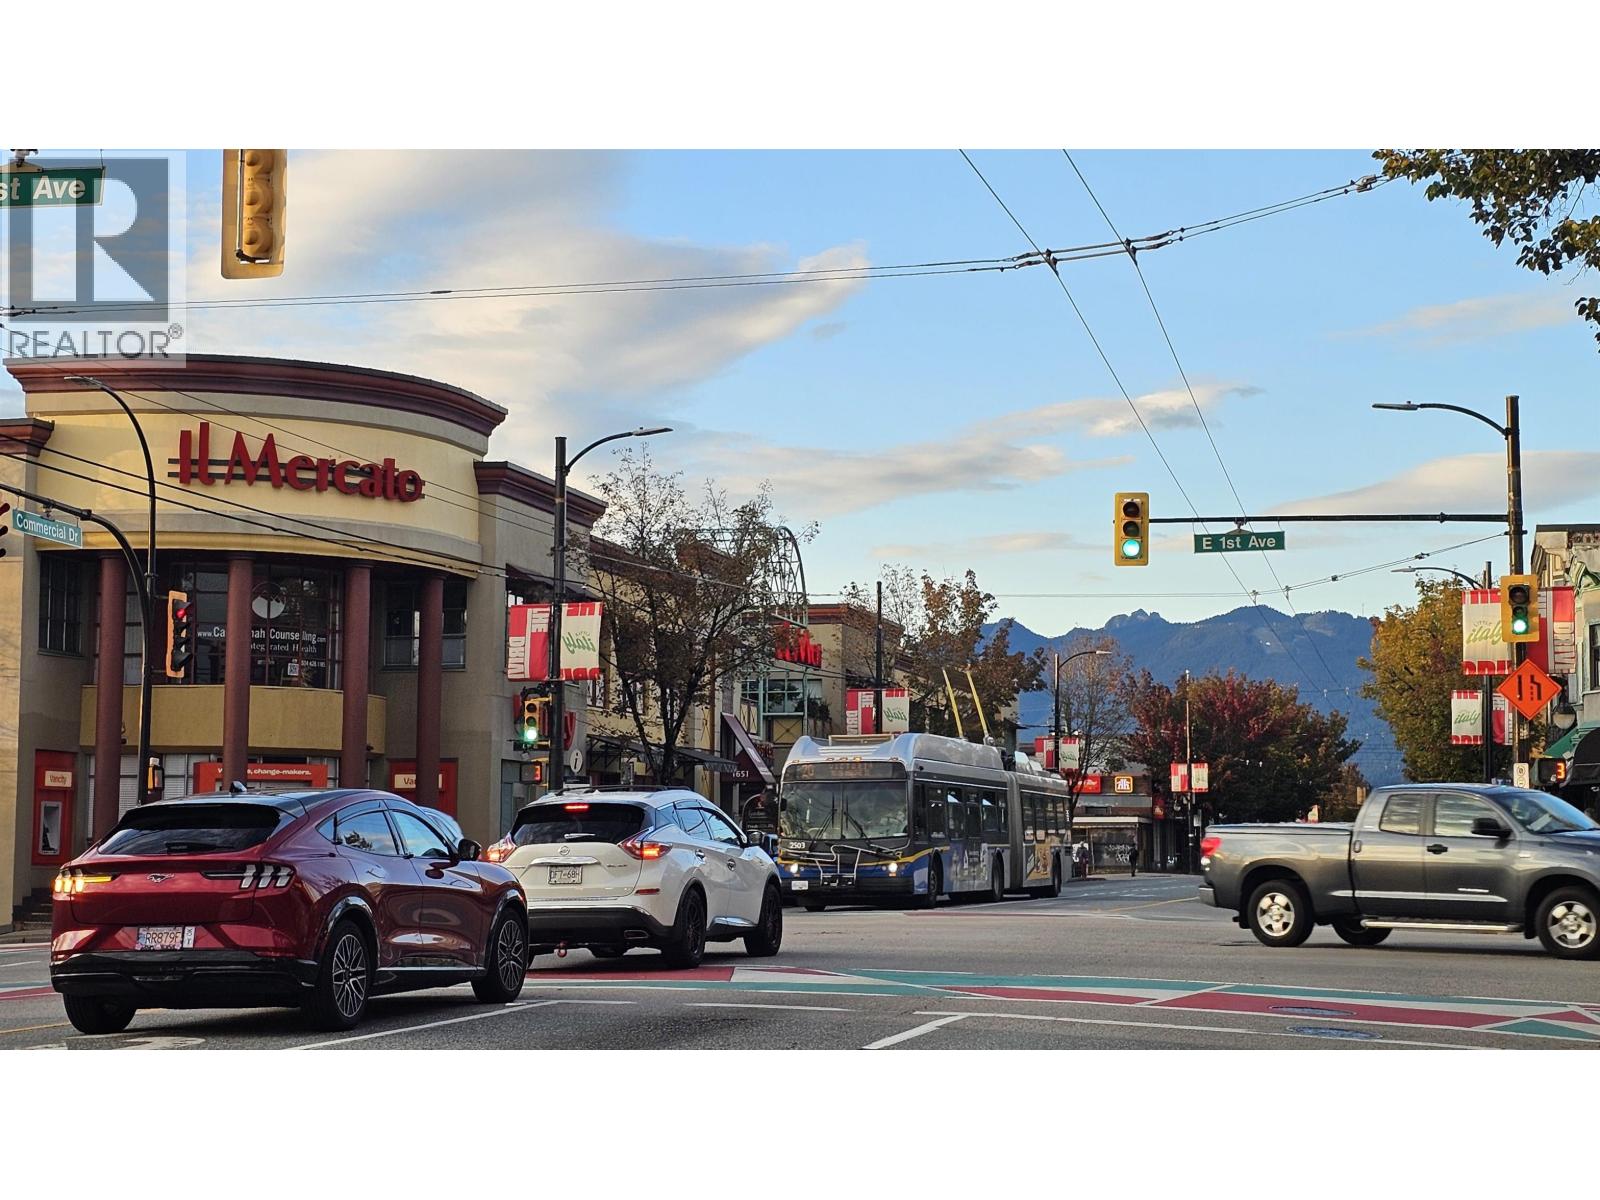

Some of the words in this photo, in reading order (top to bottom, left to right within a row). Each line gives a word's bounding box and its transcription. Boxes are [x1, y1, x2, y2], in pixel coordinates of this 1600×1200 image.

[33, 175, 86, 200] Ave
[179, 422, 215, 486] Il
[224, 431, 423, 502] Mercato
[16, 513, 66, 540] Commercial
[68, 528, 78, 542] Dr
[1202, 537, 1213, 550] E
[1219, 536, 1241, 549] 1st
[1248, 535, 1276, 548] Ave
[1454, 710, 1480, 725] italy
[253, 768, 312, 776] change-makers.
[1557, 763, 1565, 779] 3
